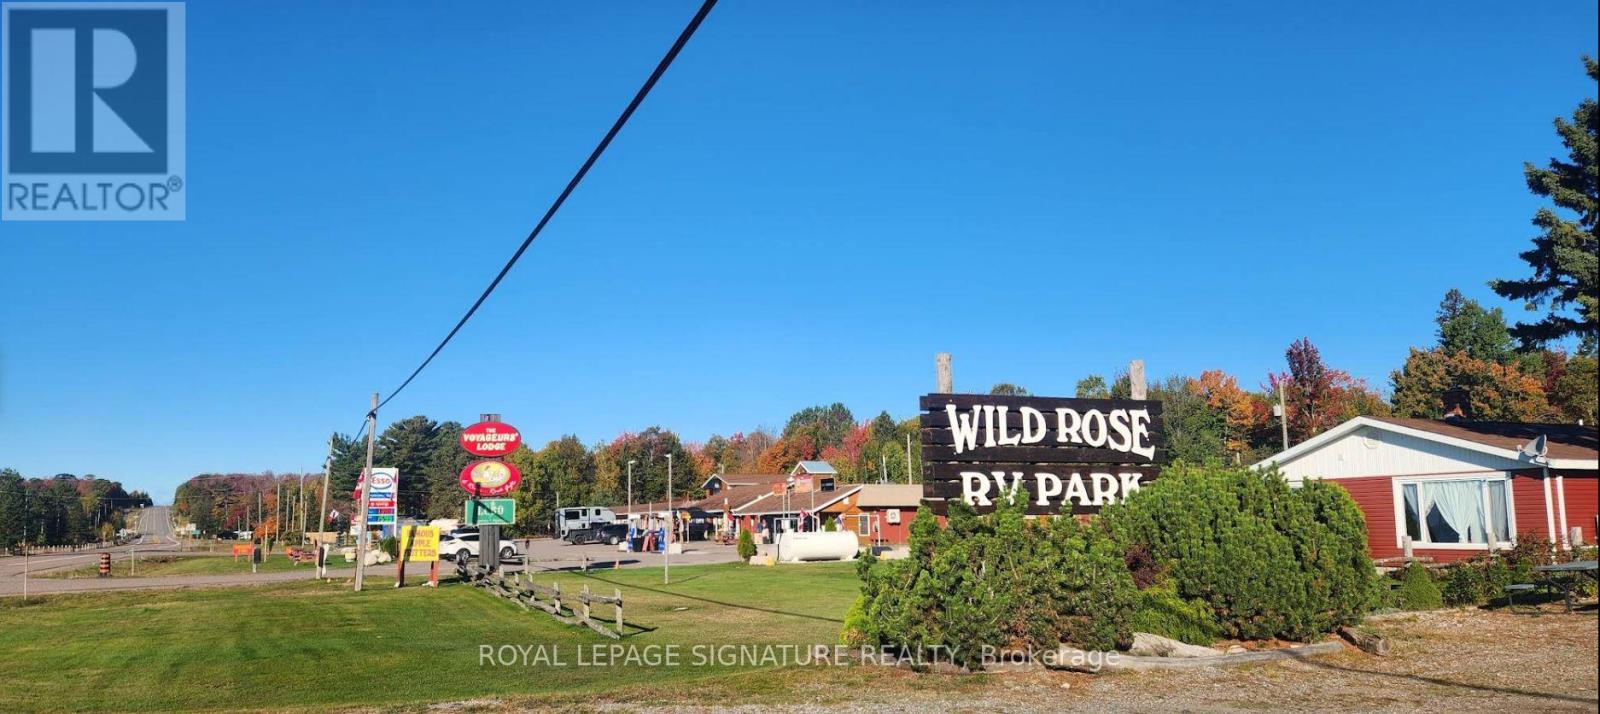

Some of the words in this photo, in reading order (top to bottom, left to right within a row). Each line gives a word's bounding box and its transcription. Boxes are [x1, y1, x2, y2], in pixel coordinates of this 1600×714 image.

[476, 443, 507, 451] LODGE
[946, 404, 1047, 454] WILD
[1055, 408, 1156, 461] ROSE
[960, 471, 1024, 506] RV
[1035, 472, 1143, 506] PARK
